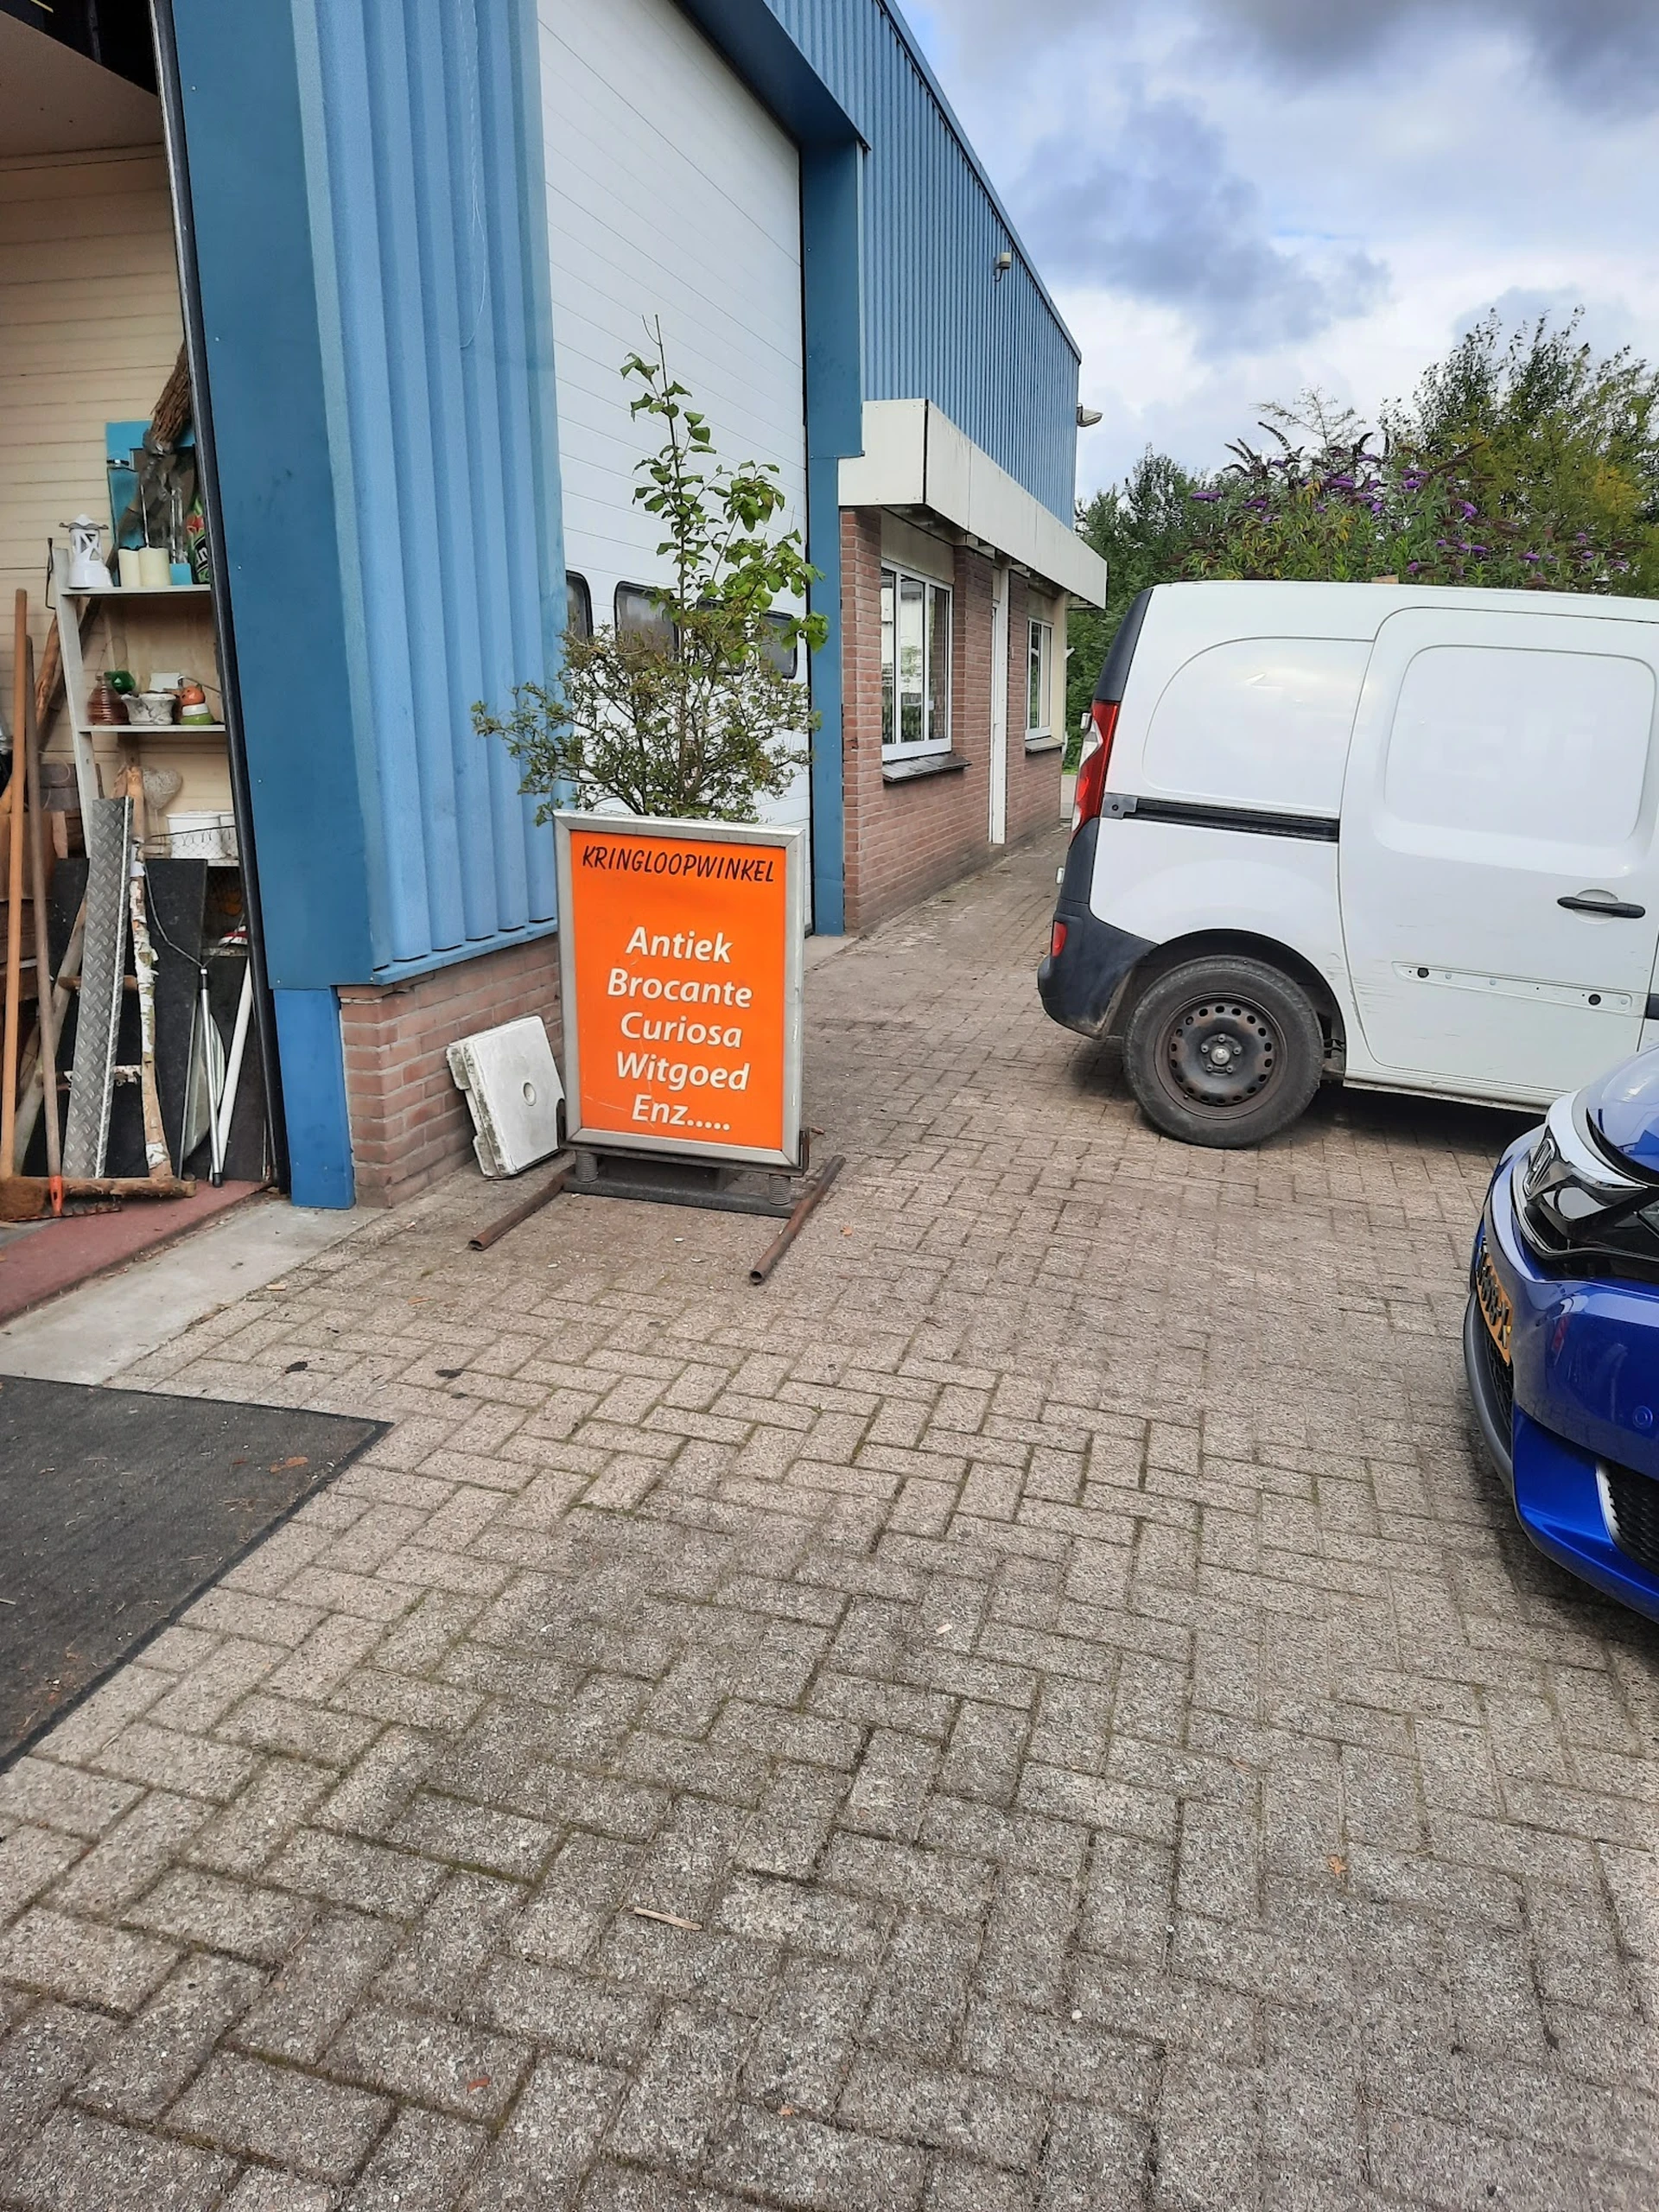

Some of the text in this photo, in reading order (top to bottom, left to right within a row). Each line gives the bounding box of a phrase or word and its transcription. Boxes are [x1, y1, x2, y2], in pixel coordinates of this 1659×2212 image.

[582, 845, 775, 883] KRINGLOOPWINKEL
[625, 926, 733, 964] Antiek
[607, 968, 753, 1008] Brocante
[620, 1011, 742, 1048] Curiosa
[617, 1051, 750, 1091] Witgoed
